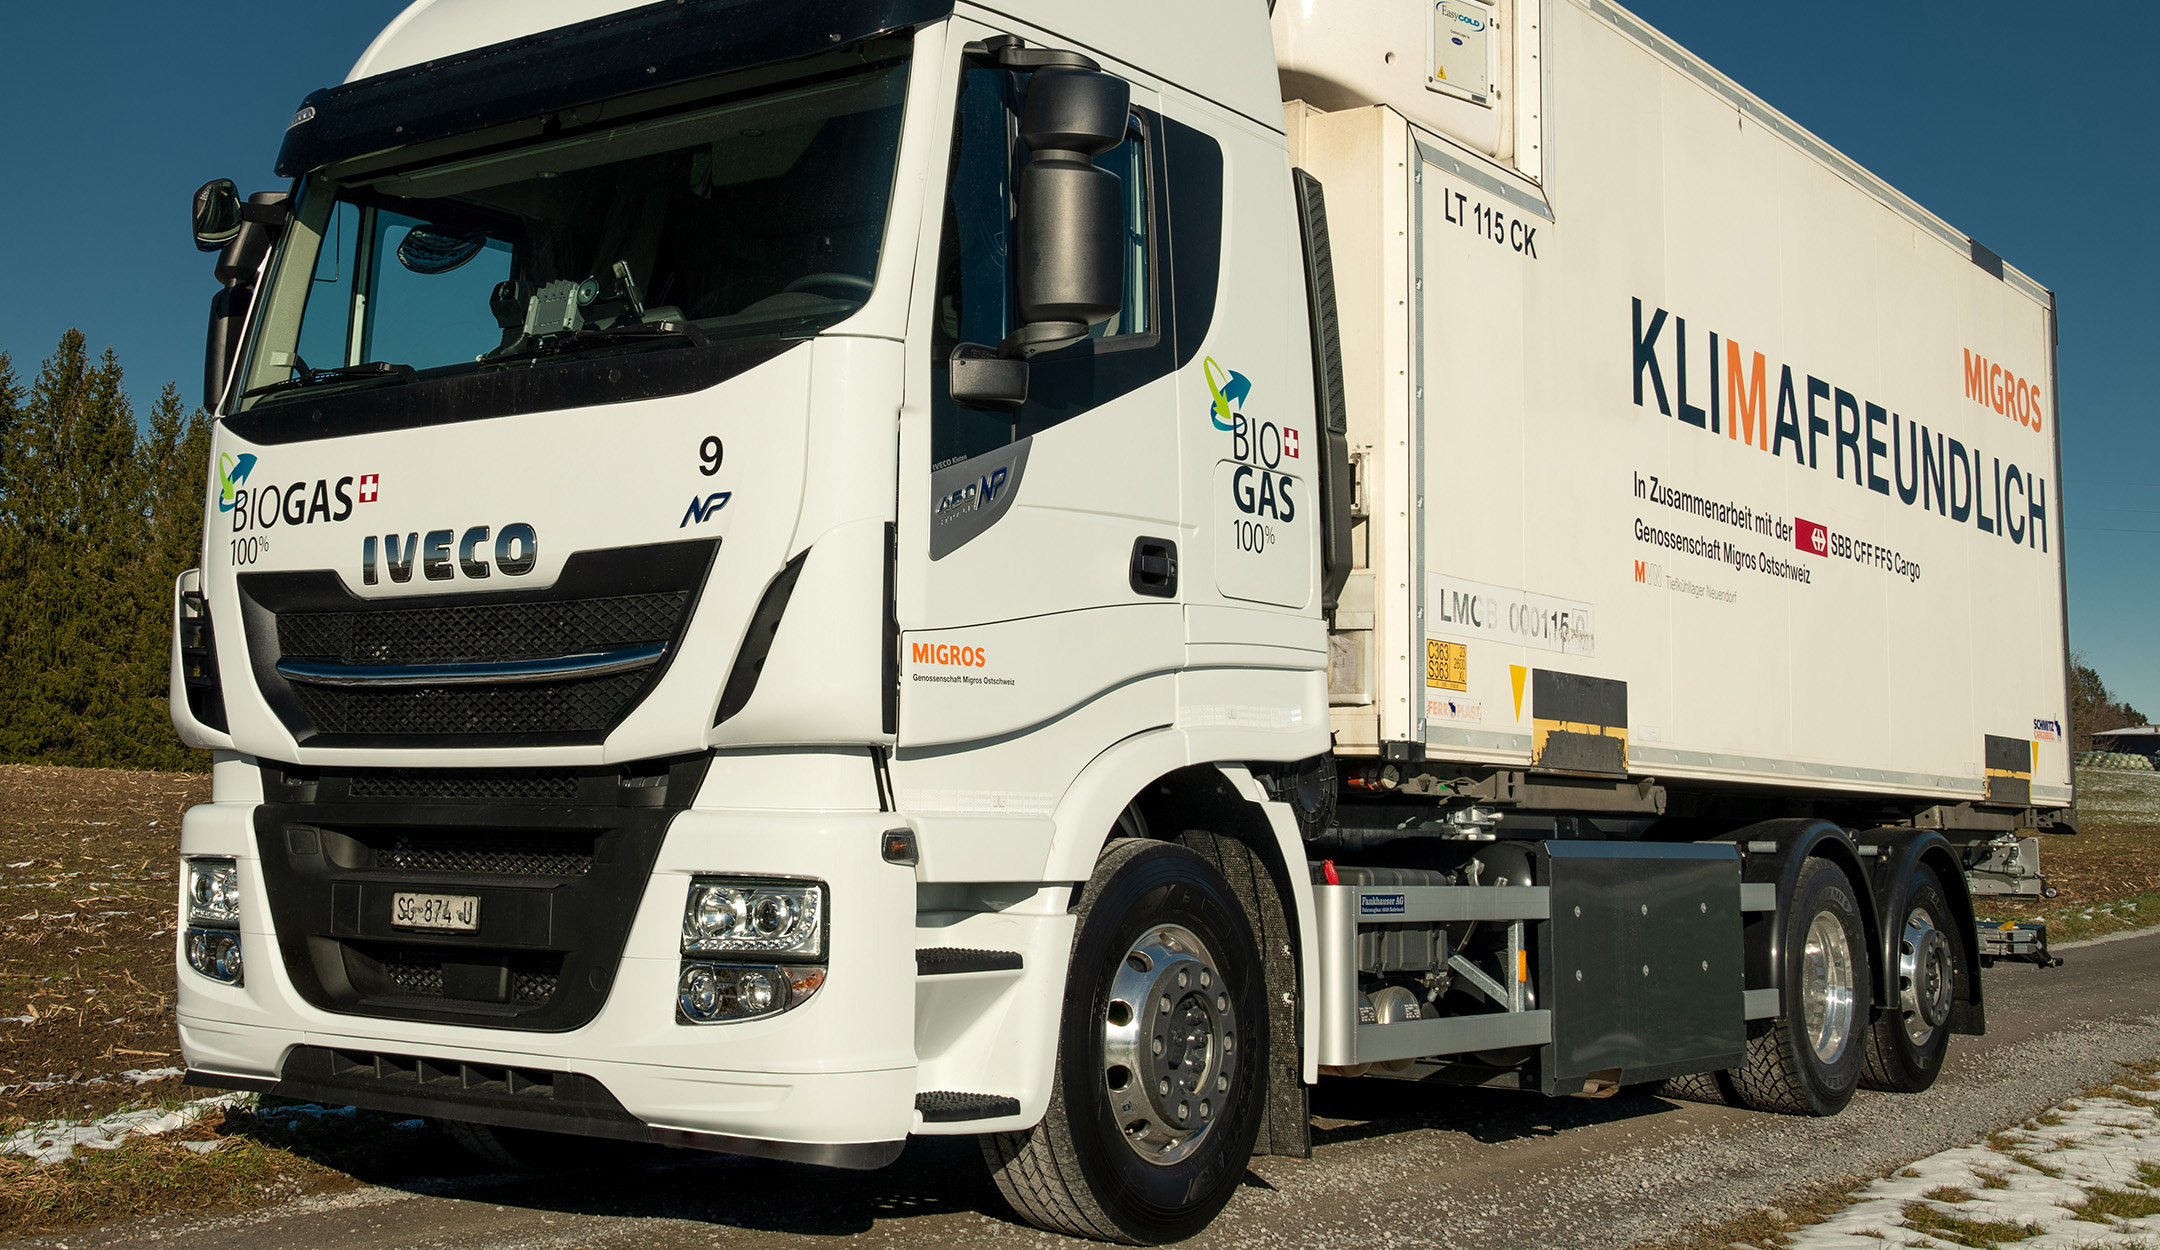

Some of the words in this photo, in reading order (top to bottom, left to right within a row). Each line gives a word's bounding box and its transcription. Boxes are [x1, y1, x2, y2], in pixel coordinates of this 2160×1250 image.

[1442, 4, 1480, 27] EasyCOLD
[1444, 187, 1467, 228] LT
[1474, 202, 1504, 246] 115
[1511, 218, 1537, 260] CK
[1963, 347, 2042, 434] MIGROS
[1232, 412, 1281, 469] BIO
[1631, 296, 2048, 554] KLIMAFREUNDLICH
[699, 435, 724, 476] 9
[932, 458, 951, 471] IVECO
[232, 475, 354, 533] BIOGAS
[679, 491, 732, 528] NP
[1233, 465, 1295, 523] GAS
[1233, 519, 1276, 554] 100%
[1634, 470, 1646, 500] In
[1650, 475, 1752, 532] Zusammenarbeit
[1755, 512, 1773, 538] mit
[1775, 516, 1793, 543] der
[1830, 532, 1852, 560] SBB
[1854, 539, 1873, 565] CFF
[1875, 545, 1893, 572] FFS
[1894, 552, 1921, 583] Cargo
[230, 534, 270, 566] 100%
[361, 522, 538, 586] IVECO
[1634, 517, 1721, 561] Genossenschaft
[1724, 541, 1757, 572] Migros
[1758, 551, 1811, 585] Ostschweiz
[1706, 584, 1737, 604] Neuendorf
[912, 642, 986, 668] MIGROS
[1428, 641, 1449, 662] C363
[912, 673, 962, 684] Genossenschaft
[963, 675, 983, 686] Migros
[984, 676, 1015, 686] Ostschweiz
[1428, 660, 1449, 680] S363
[2033, 718, 2054, 732] SCHMITZ
[397, 897, 415, 921] SG
[424, 899, 452, 924] 874
[463, 900, 473, 925] U
[1362, 896, 1395, 905] Fankhauser
[1396, 896, 1404, 905] AG
